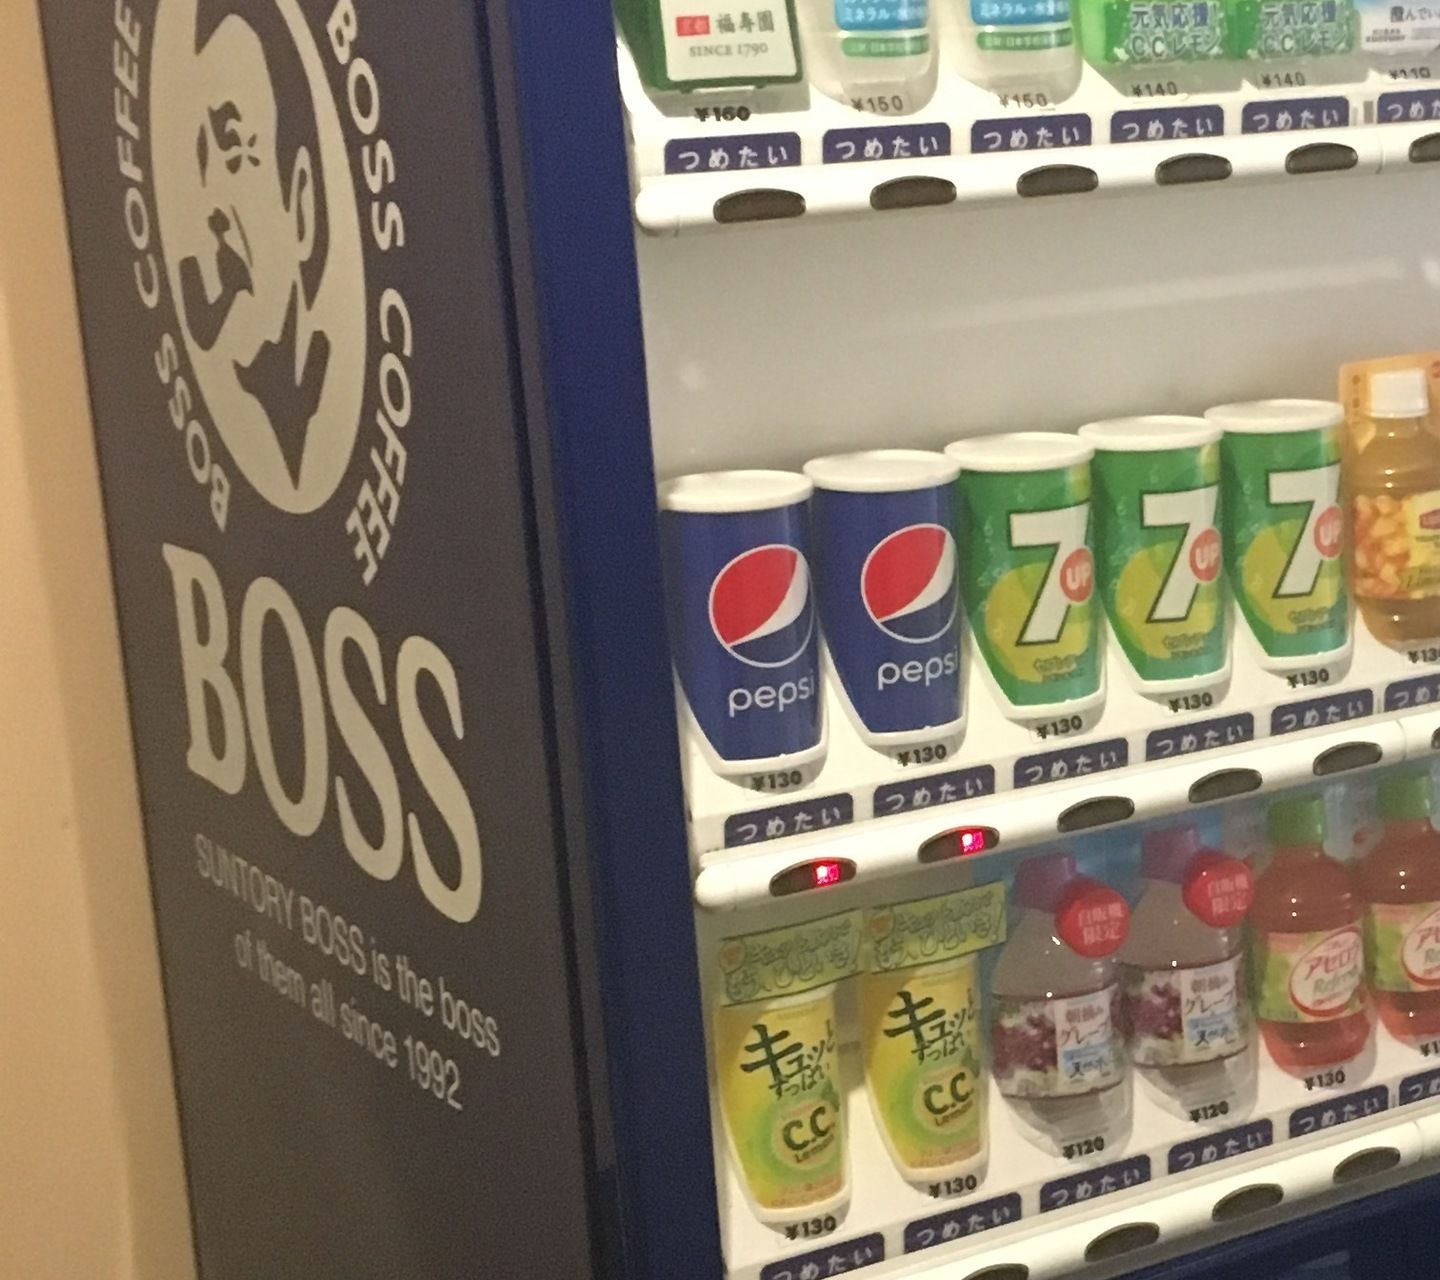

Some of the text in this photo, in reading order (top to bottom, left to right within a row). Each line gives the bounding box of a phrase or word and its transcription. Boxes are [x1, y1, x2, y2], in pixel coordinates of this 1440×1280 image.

[689, 42, 769, 58] SINCE 1790
[1262, 72, 1306, 88] ¥140
[1389, 66, 1431, 80] ¥110
[1000, 93, 1048, 109] ¥150
[1131, 81, 1178, 97] ¥140
[851, 95, 904, 113] ¥150
[1122, 118, 1213, 141] つめたい
[1252, 109, 1339, 131] つめたい
[836, 135, 939, 160] つめたい
[984, 126, 1080, 150] つめたい
[678, 145, 788, 170] つめたい
[155, 331, 232, 532] BOSS
[346, 287, 412, 585] COFFEE
[1268, 459, 1342, 600] 7
[1141, 485, 1220, 624] 7
[1009, 501, 1091, 647] 7
[877, 645, 959, 691] pepsi
[1287, 668, 1330, 688] ¥130
[729, 672, 815, 718] pepsi
[1169, 692, 1214, 715] ¥130
[1036, 715, 1084, 740] ¥130
[1280, 699, 1365, 731] つめたい
[162, 542, 484, 923] BOSS
[1157, 725, 1245, 755] つめたい
[898, 743, 948, 767] ¥130
[1025, 751, 1118, 783] つめたい
[751, 769, 804, 792] ¥130
[887, 778, 984, 810] つめたい
[737, 806, 842, 843] つめたい
[195, 833, 499, 1057] SUNTORY BOSS is the boss
[235, 929, 463, 1111] of them all since 1992
[1304, 1070, 1347, 1092] ¥130
[1189, 1101, 1230, 1122] ¥120
[1299, 1096, 1381, 1131] つめたい
[1063, 1136, 1106, 1159] ¥120
[1179, 1133, 1263, 1169] つめたい
[929, 1175, 978, 1199] ¥130
[1050, 1167, 1142, 1205] つめたい
[785, 1214, 838, 1242] ¥130
[917, 1206, 1012, 1245] つめたい
